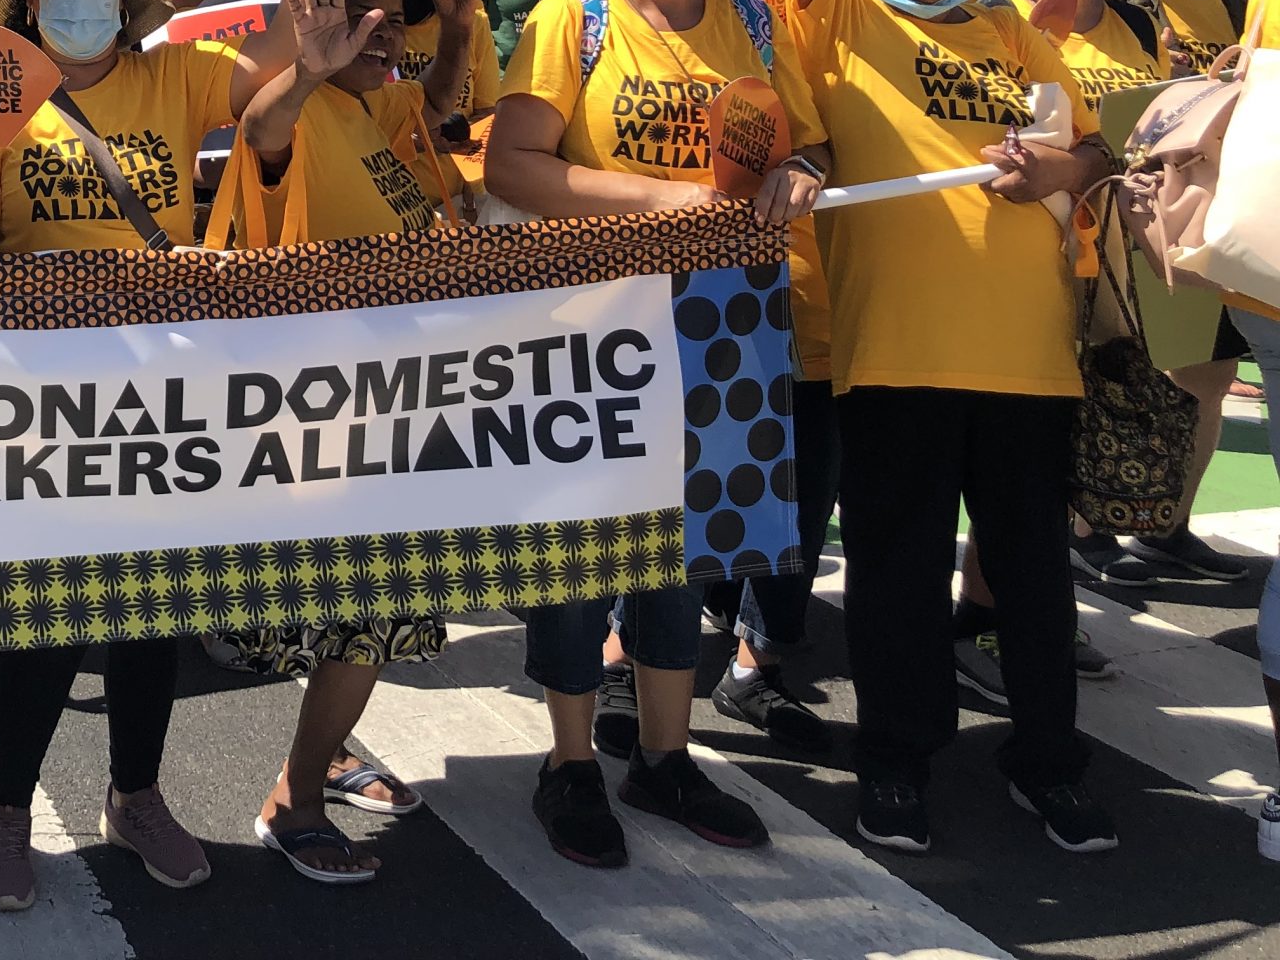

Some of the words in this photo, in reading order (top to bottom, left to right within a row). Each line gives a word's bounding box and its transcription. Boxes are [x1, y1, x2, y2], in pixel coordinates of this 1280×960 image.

[611, 94, 709, 124] DOME
[724, 107, 776, 148] DOMESTIC
[729, 93, 777, 134] NATIONAL
[360, 147, 401, 176] NATIO
[717, 139, 766, 177] ALLIANCE
[722, 123, 770, 162] WORKERS
[226, 328, 656, 429] DOMESTIC
[238, 396, 646, 488] ALLIANCE
